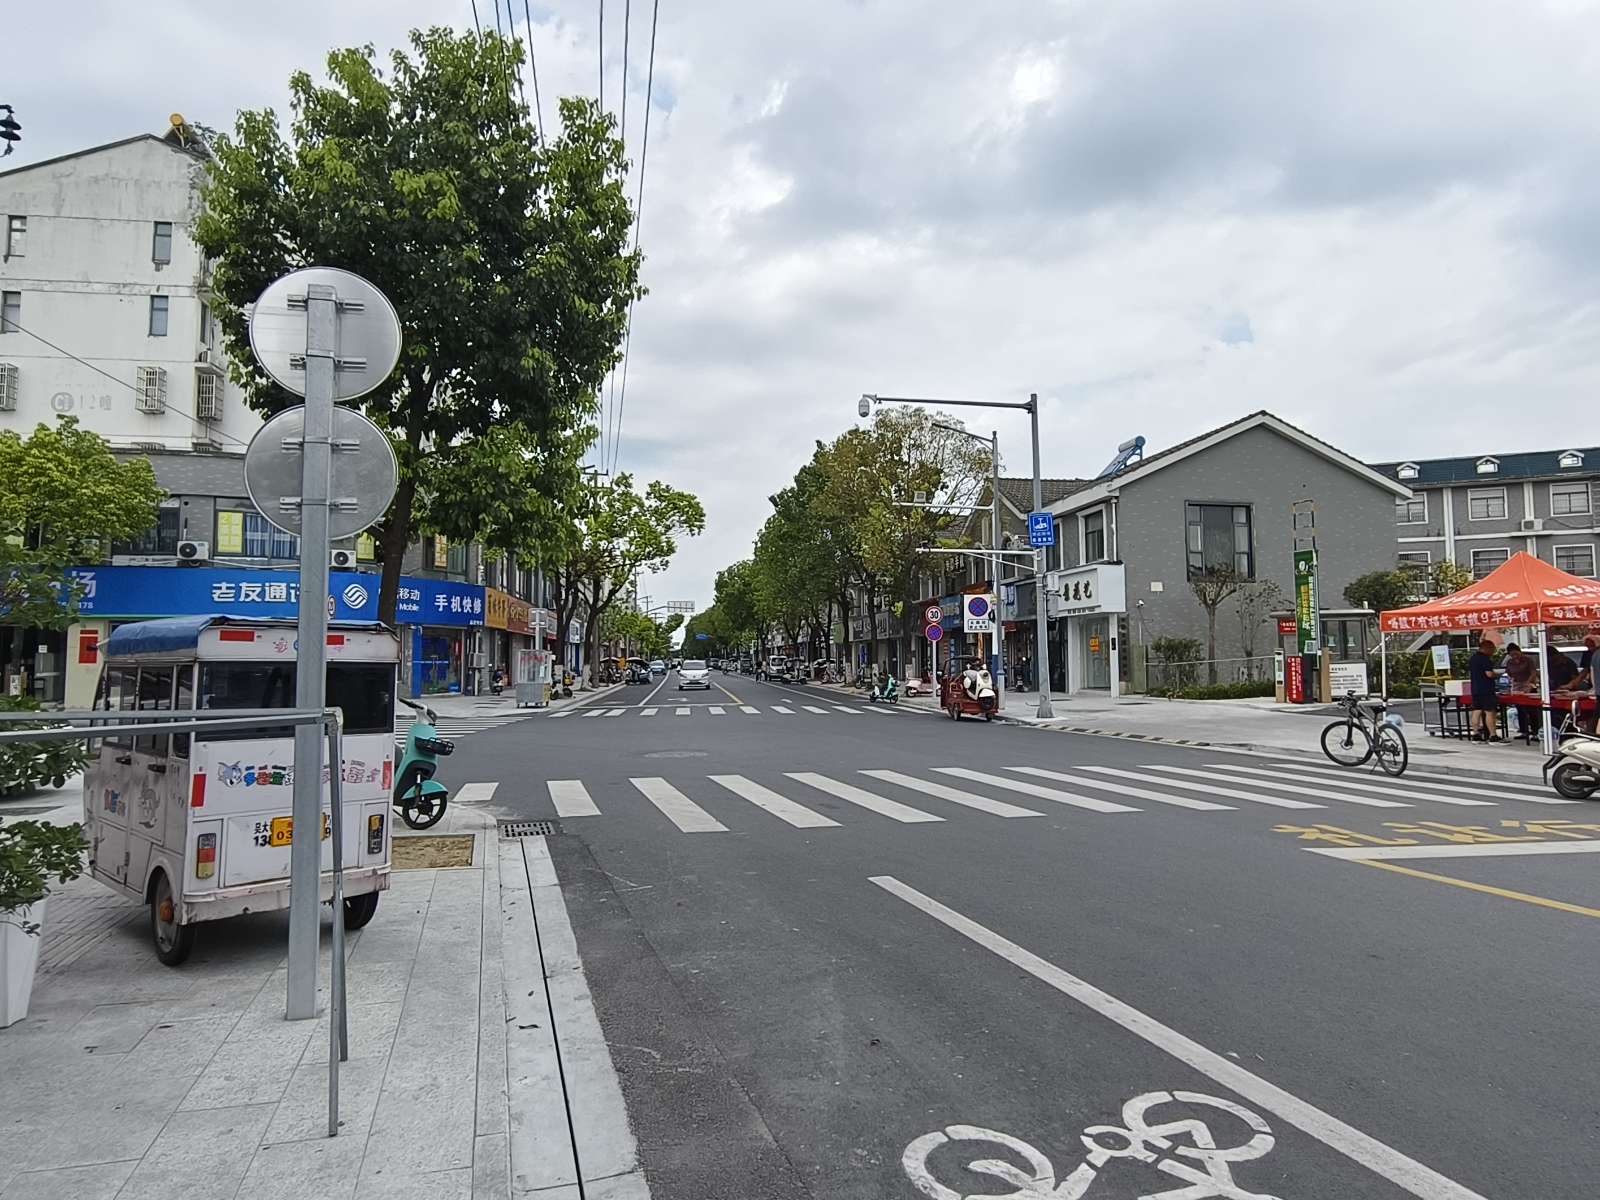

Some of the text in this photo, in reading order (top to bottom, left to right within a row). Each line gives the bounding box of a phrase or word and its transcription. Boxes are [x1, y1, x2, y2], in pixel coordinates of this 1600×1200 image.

[397, 588, 421, 601] 移动
[434, 594, 482, 614] 手机快修
[930, 610, 939, 620] 30
